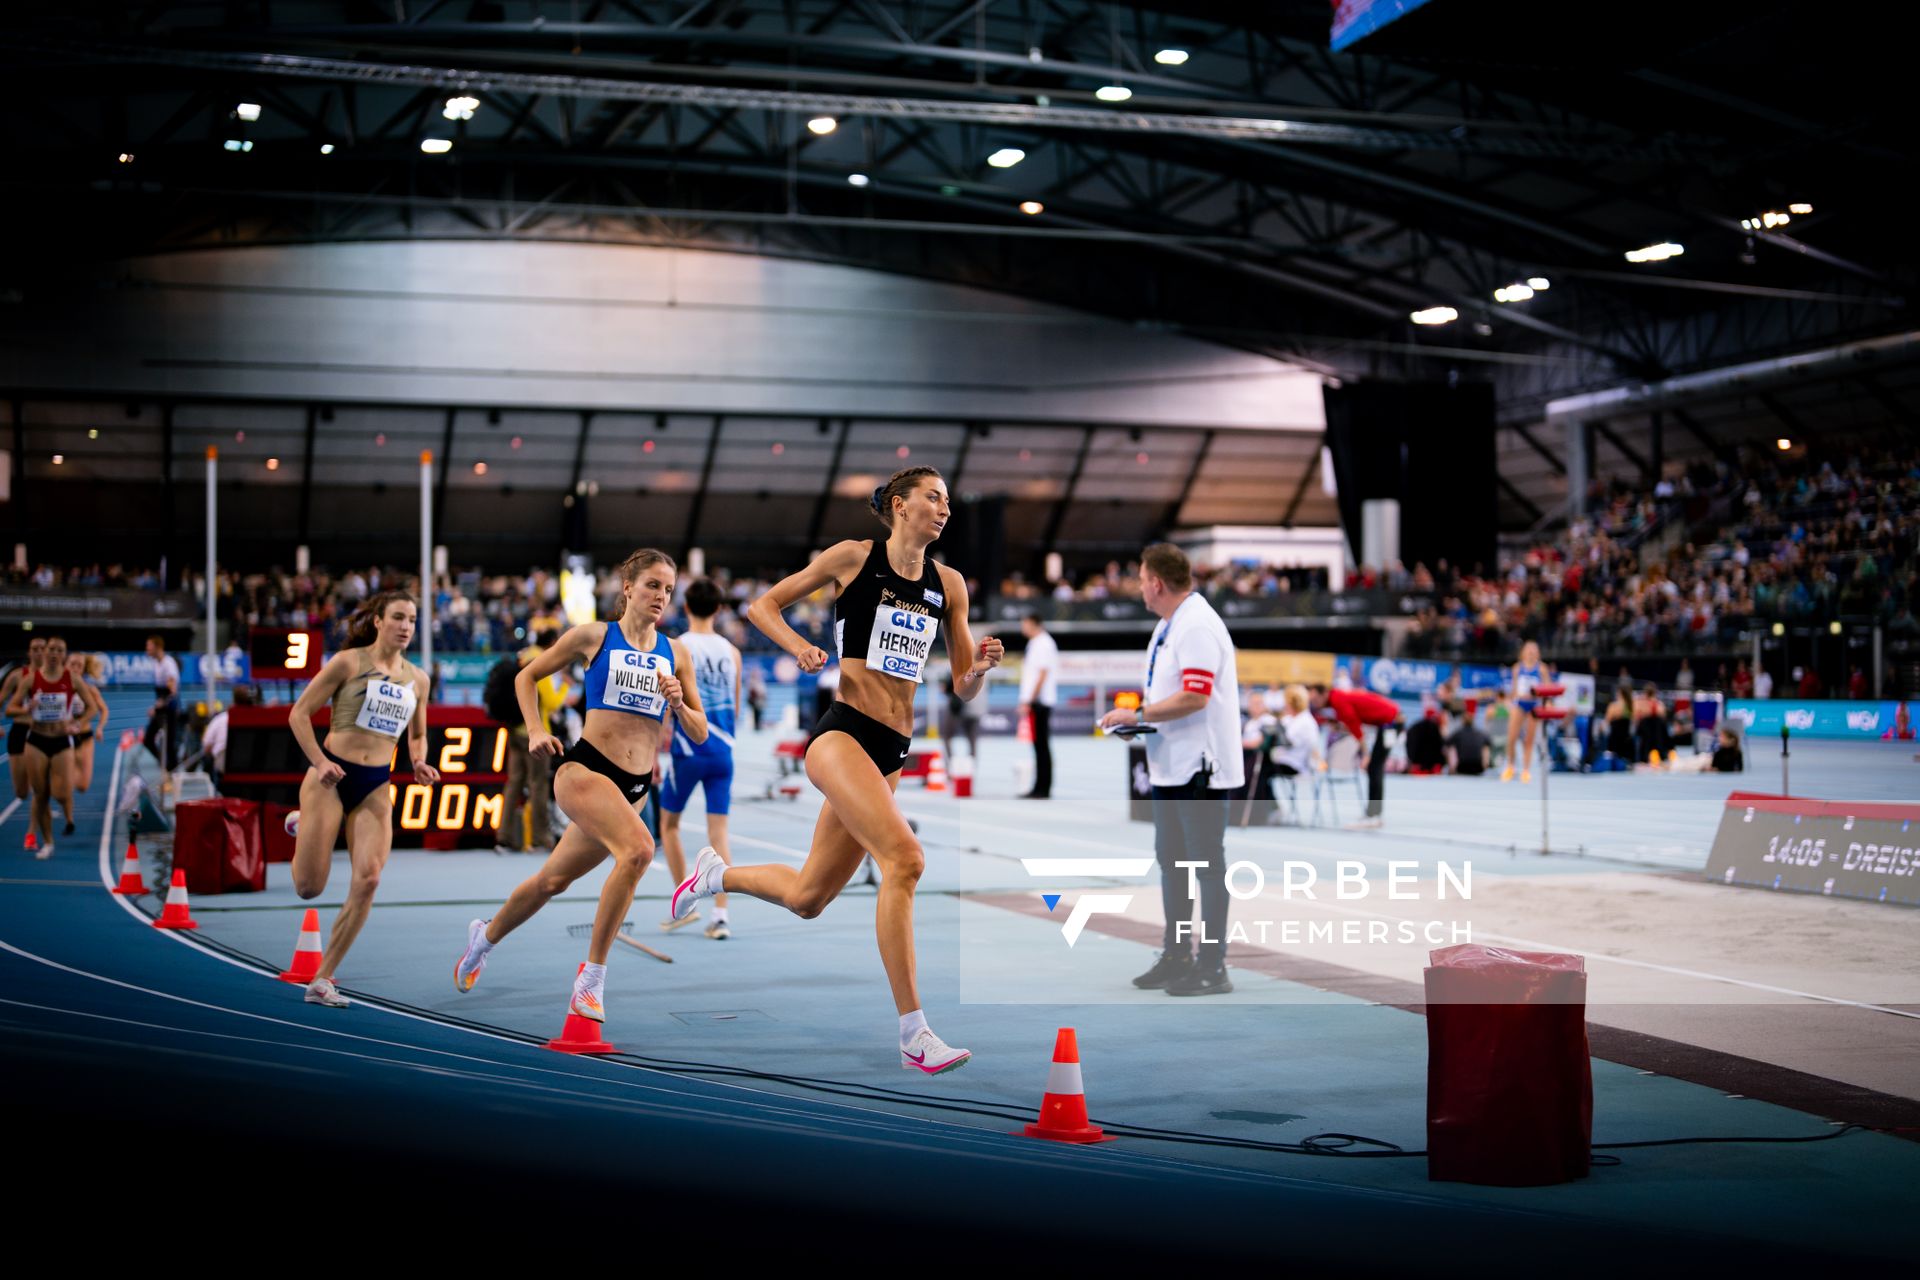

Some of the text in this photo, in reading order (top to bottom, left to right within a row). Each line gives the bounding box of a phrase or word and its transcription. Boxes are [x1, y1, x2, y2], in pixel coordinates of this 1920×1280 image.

[284, 632, 310, 670] 3
[879, 631, 927, 659] HERING
[899, 661, 918, 673] PLAN
[379, 684, 403, 699] GLS
[634, 696, 652, 706] PLAN
